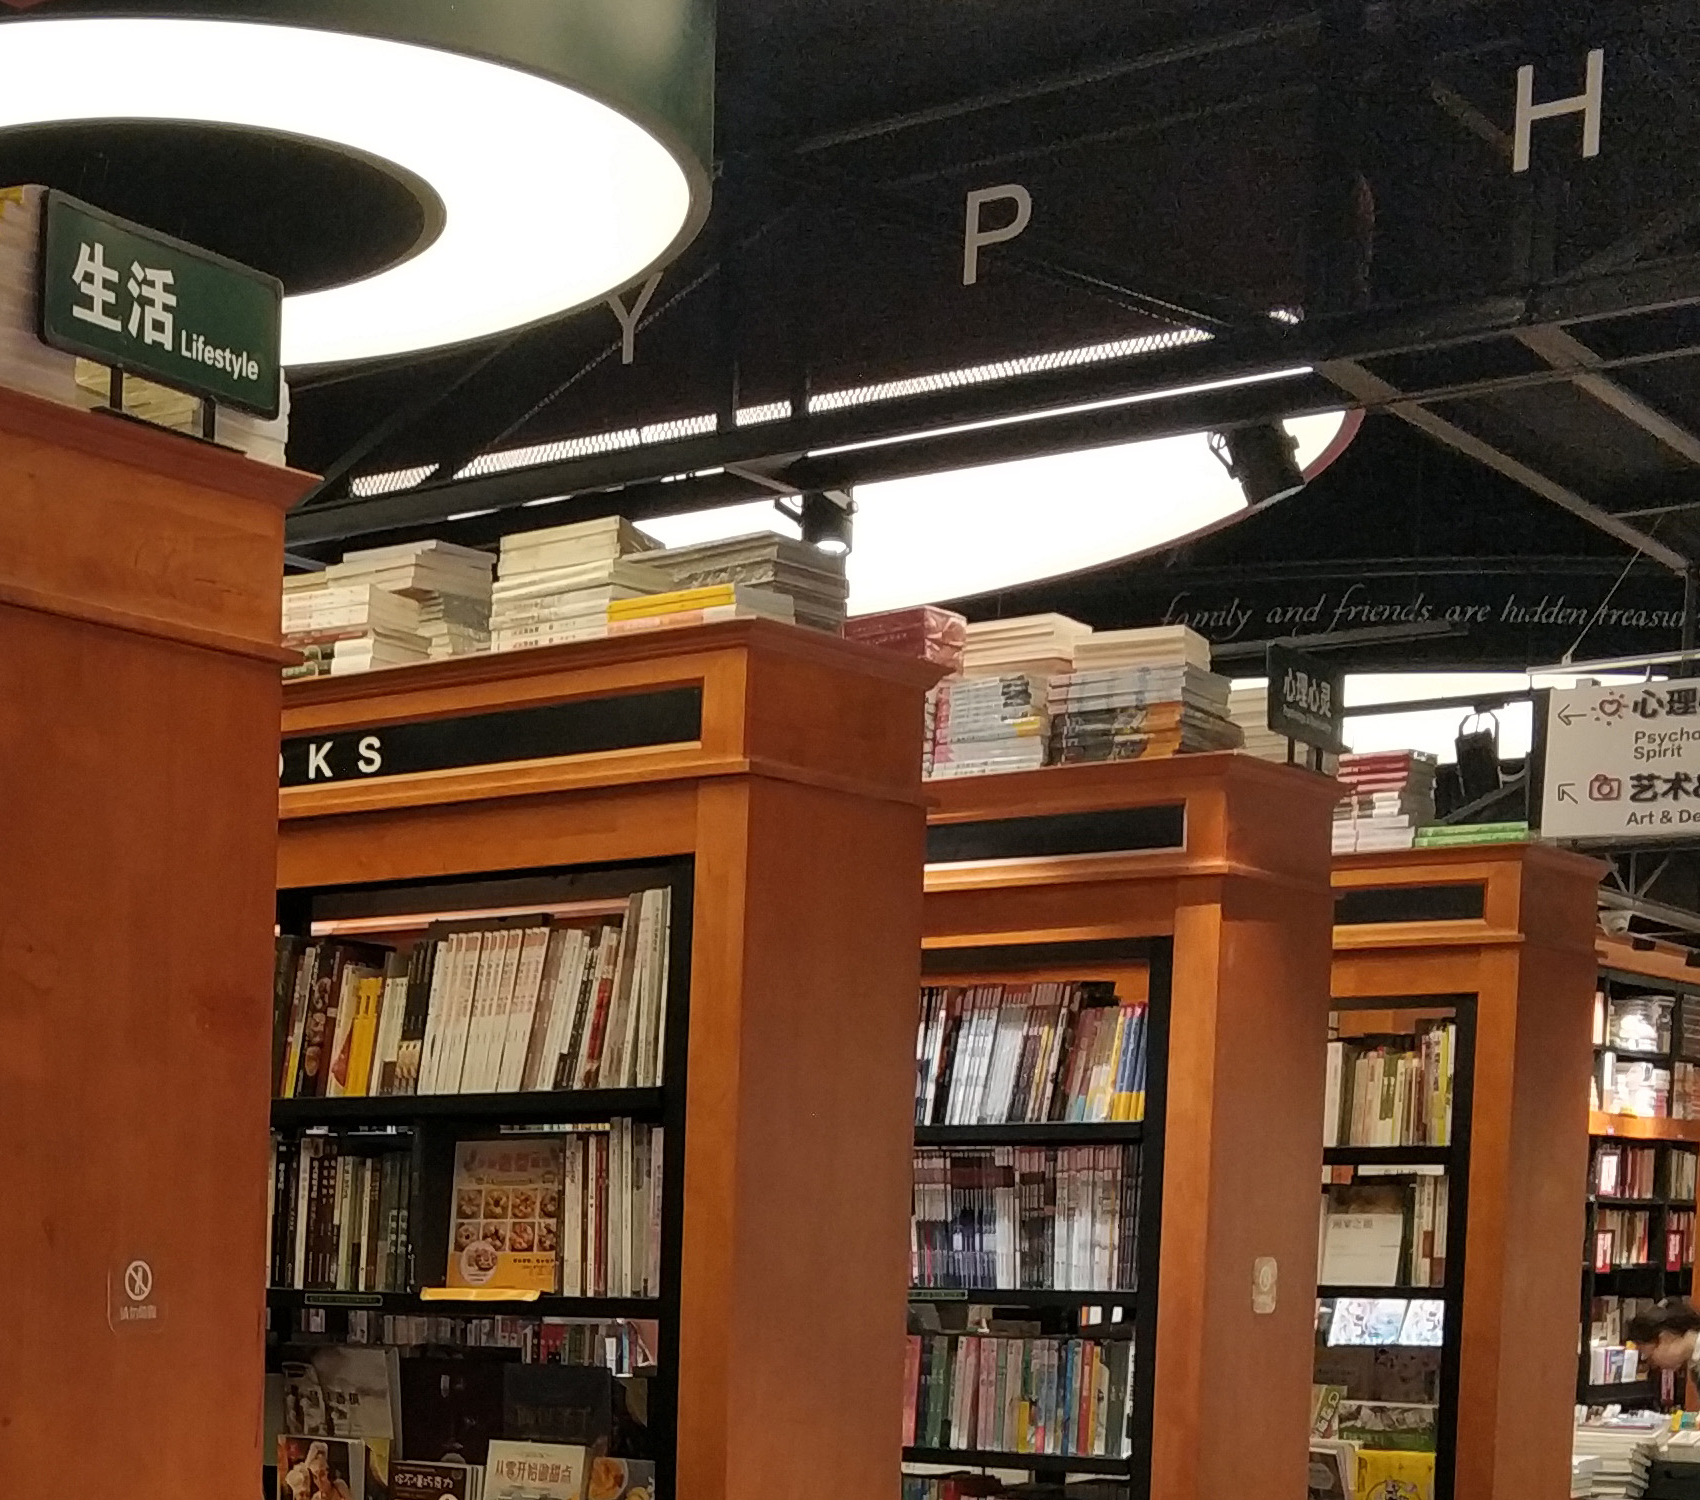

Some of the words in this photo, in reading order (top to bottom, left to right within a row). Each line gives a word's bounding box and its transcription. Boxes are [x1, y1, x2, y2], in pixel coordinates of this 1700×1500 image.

[1512, 48, 1605, 173] H
[961, 183, 1033, 287] P
[71, 240, 178, 353] 生活
[180, 328, 261, 383] Lifestyle
[1266, 593, 1327, 624] and
[1327, 583, 1433, 634] friends
[1445, 602, 1492, 623] are
[1500, 594, 1588, 625] hidden
[1631, 687, 1700, 719] 心理
[280, 735, 384, 782] KS
[1633, 744, 1683, 763] Spirit
[1626, 811, 1655, 826] Art
[1659, 810, 1673, 825] &
